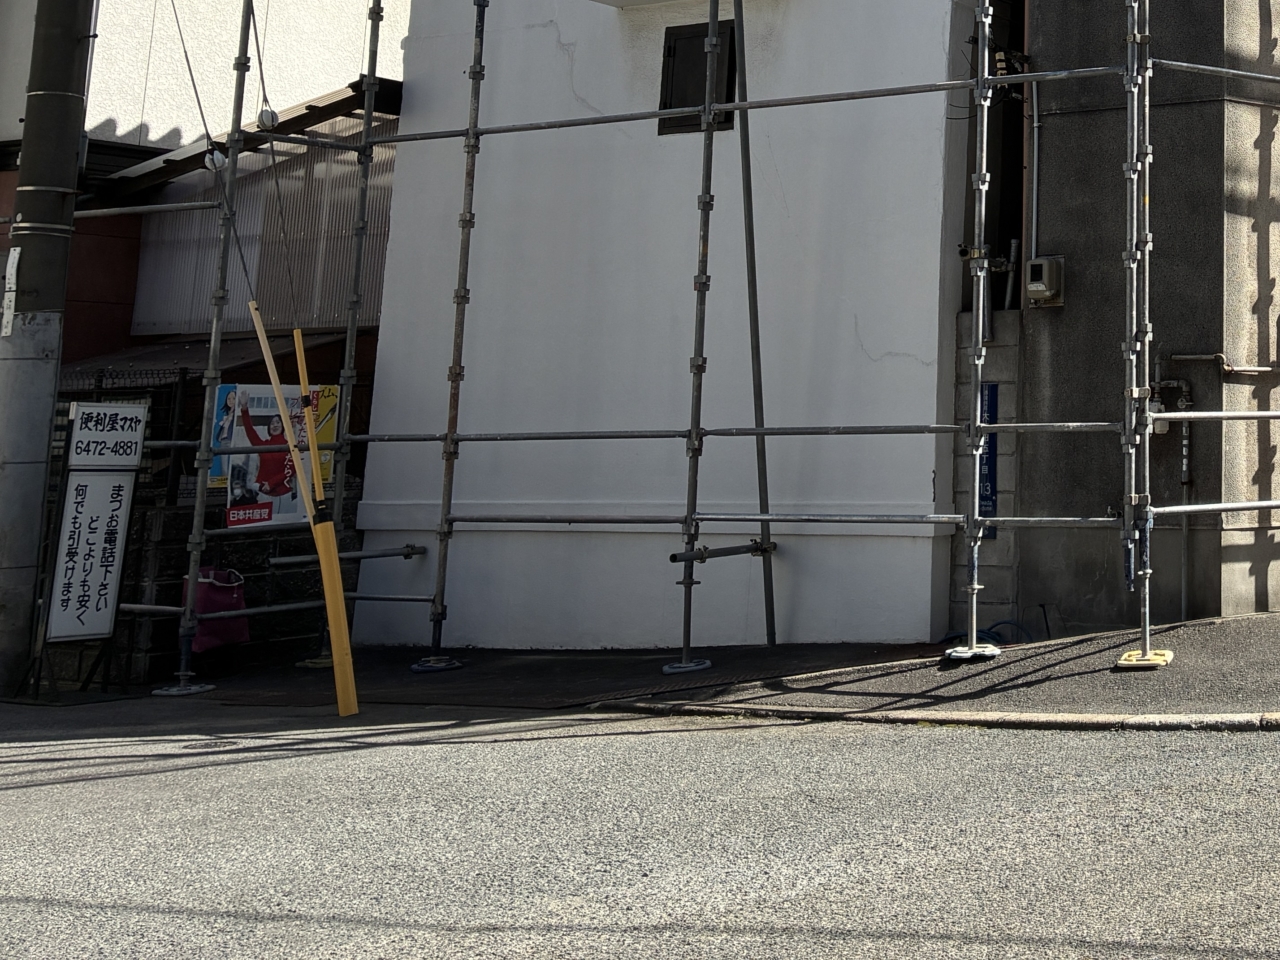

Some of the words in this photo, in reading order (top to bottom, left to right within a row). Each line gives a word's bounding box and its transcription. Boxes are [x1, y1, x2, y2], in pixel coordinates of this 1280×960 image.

[79, 411, 142, 433] 便利屋マスヤ
[75, 440, 138, 456] 6472-4881
[980, 482, 991, 495] 13
[229, 509, 269, 521] 日本共産党
[60, 483, 89, 612] 何でも引受けます
[96, 484, 125, 612] まづお電話下さい
[75, 515, 100, 626] どこよりも安く
